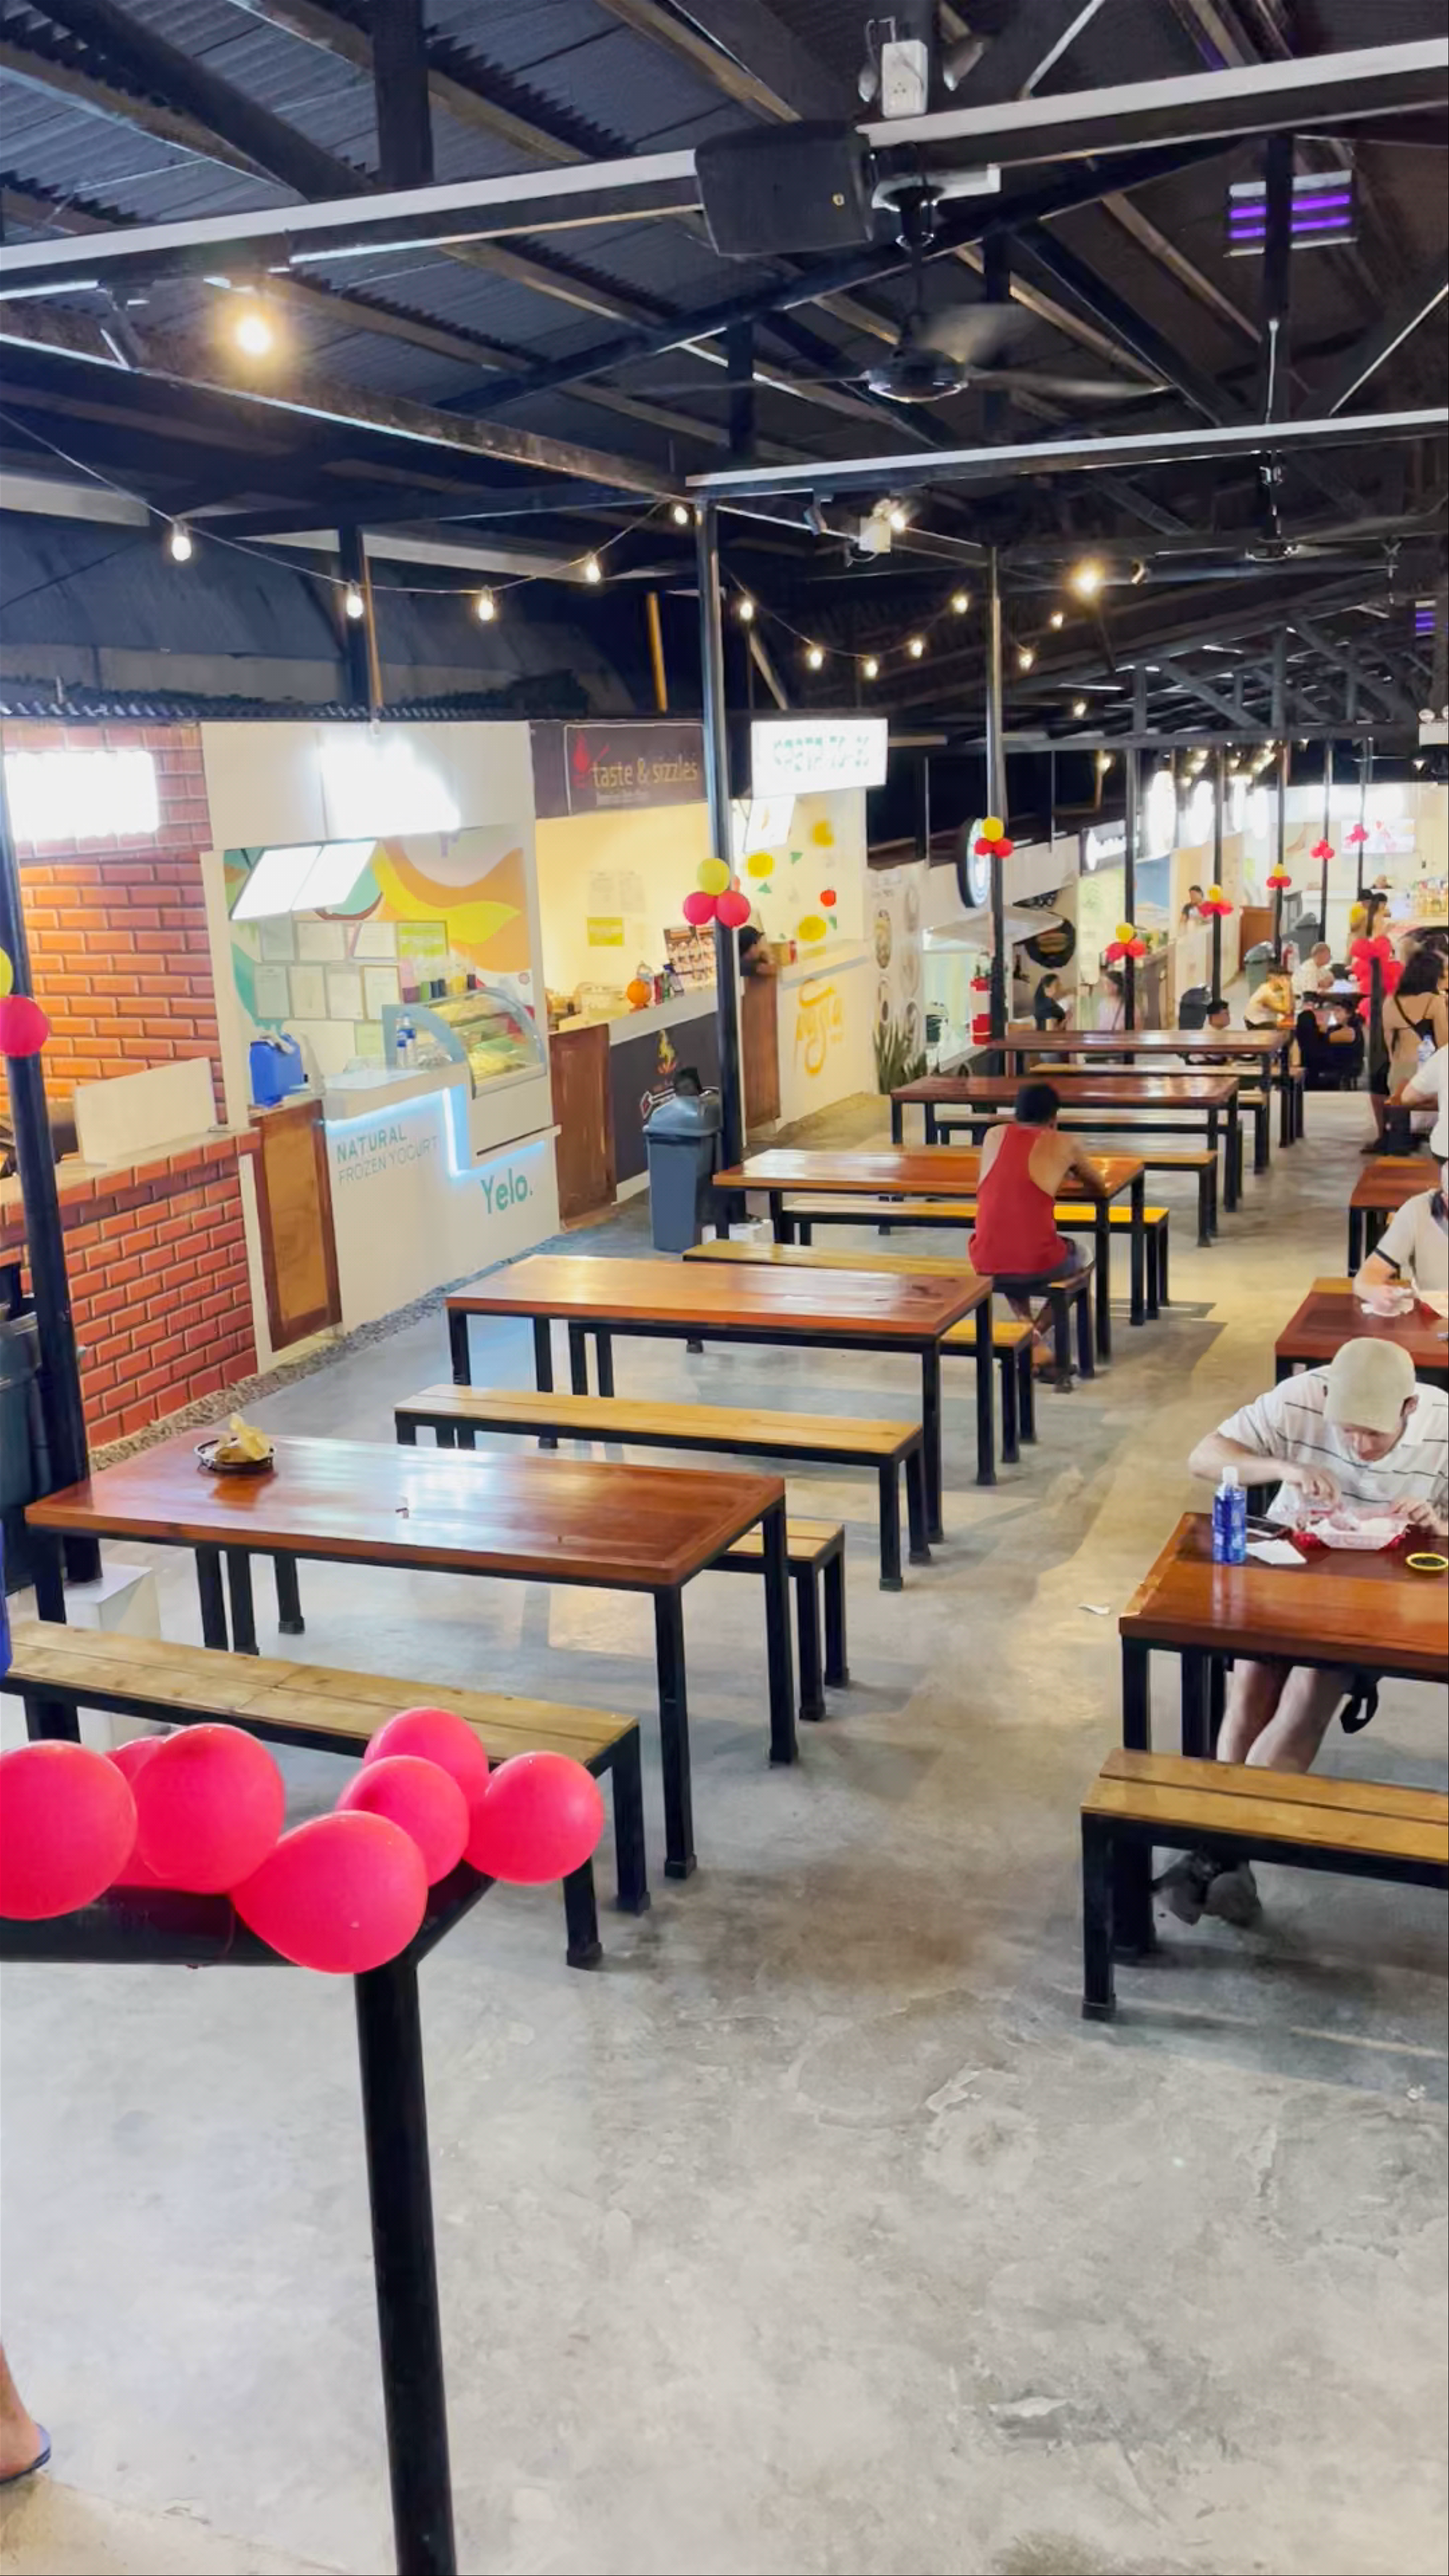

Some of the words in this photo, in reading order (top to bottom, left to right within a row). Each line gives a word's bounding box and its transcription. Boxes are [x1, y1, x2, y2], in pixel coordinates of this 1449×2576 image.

[589, 760, 634, 788] taste
[637, 757, 650, 784] &
[652, 753, 698, 784] sizzles
[337, 1124, 408, 1164] NATURAL
[338, 1155, 387, 1186] FROZEN
[388, 1135, 439, 1165] YOGURT
[480, 1167, 533, 1214] Yelo.
